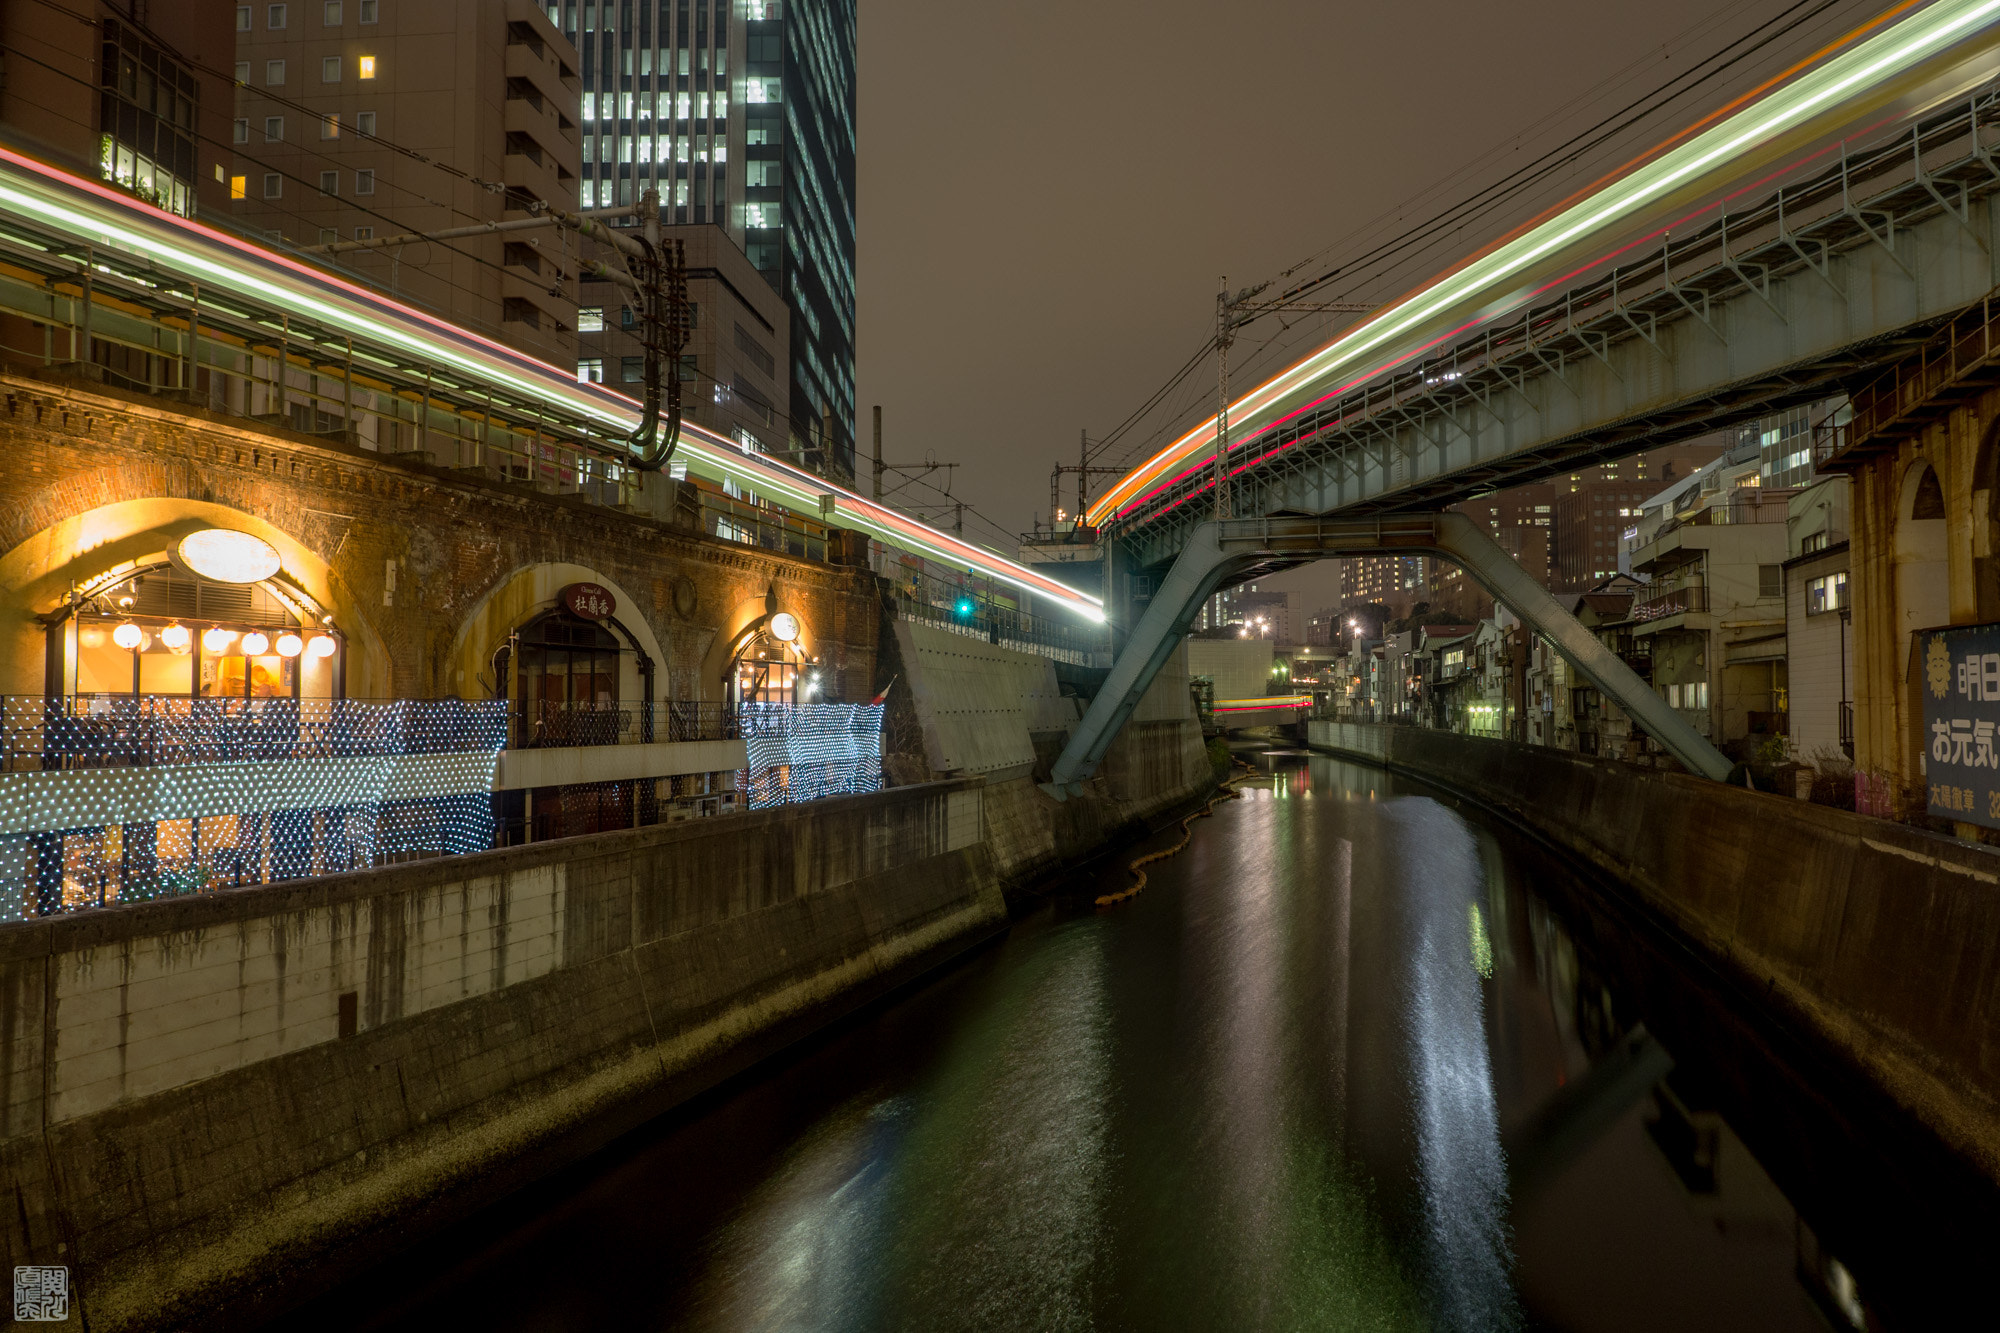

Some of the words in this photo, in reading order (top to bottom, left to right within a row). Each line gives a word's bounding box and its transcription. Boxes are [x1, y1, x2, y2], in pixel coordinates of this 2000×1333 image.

[1957, 653, 2000, 702] 明日
[1931, 718, 2000, 769] お元気
